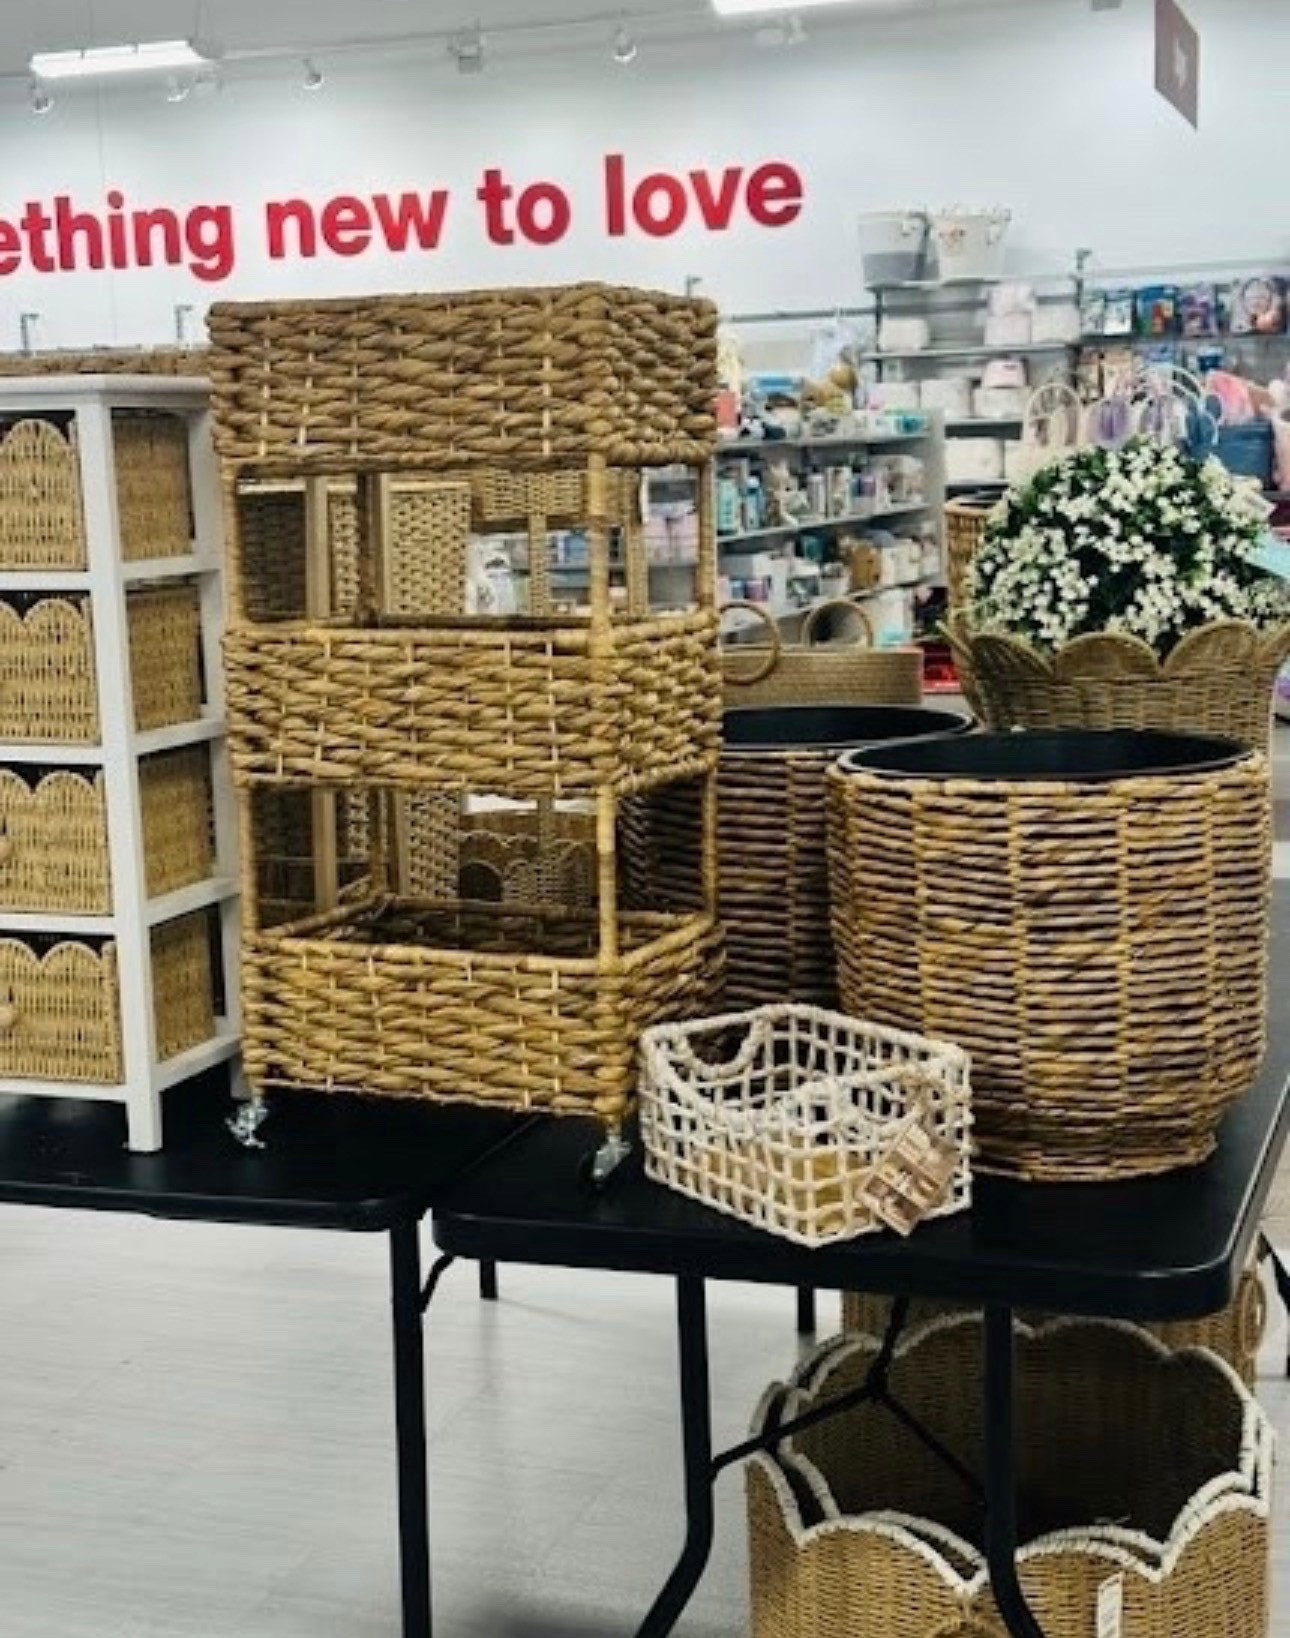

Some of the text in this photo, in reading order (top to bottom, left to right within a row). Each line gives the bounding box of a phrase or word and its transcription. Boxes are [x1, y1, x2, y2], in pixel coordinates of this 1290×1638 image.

[266, 189, 449, 260] new
[478, 169, 571, 245] to
[604, 155, 804, 237] love
